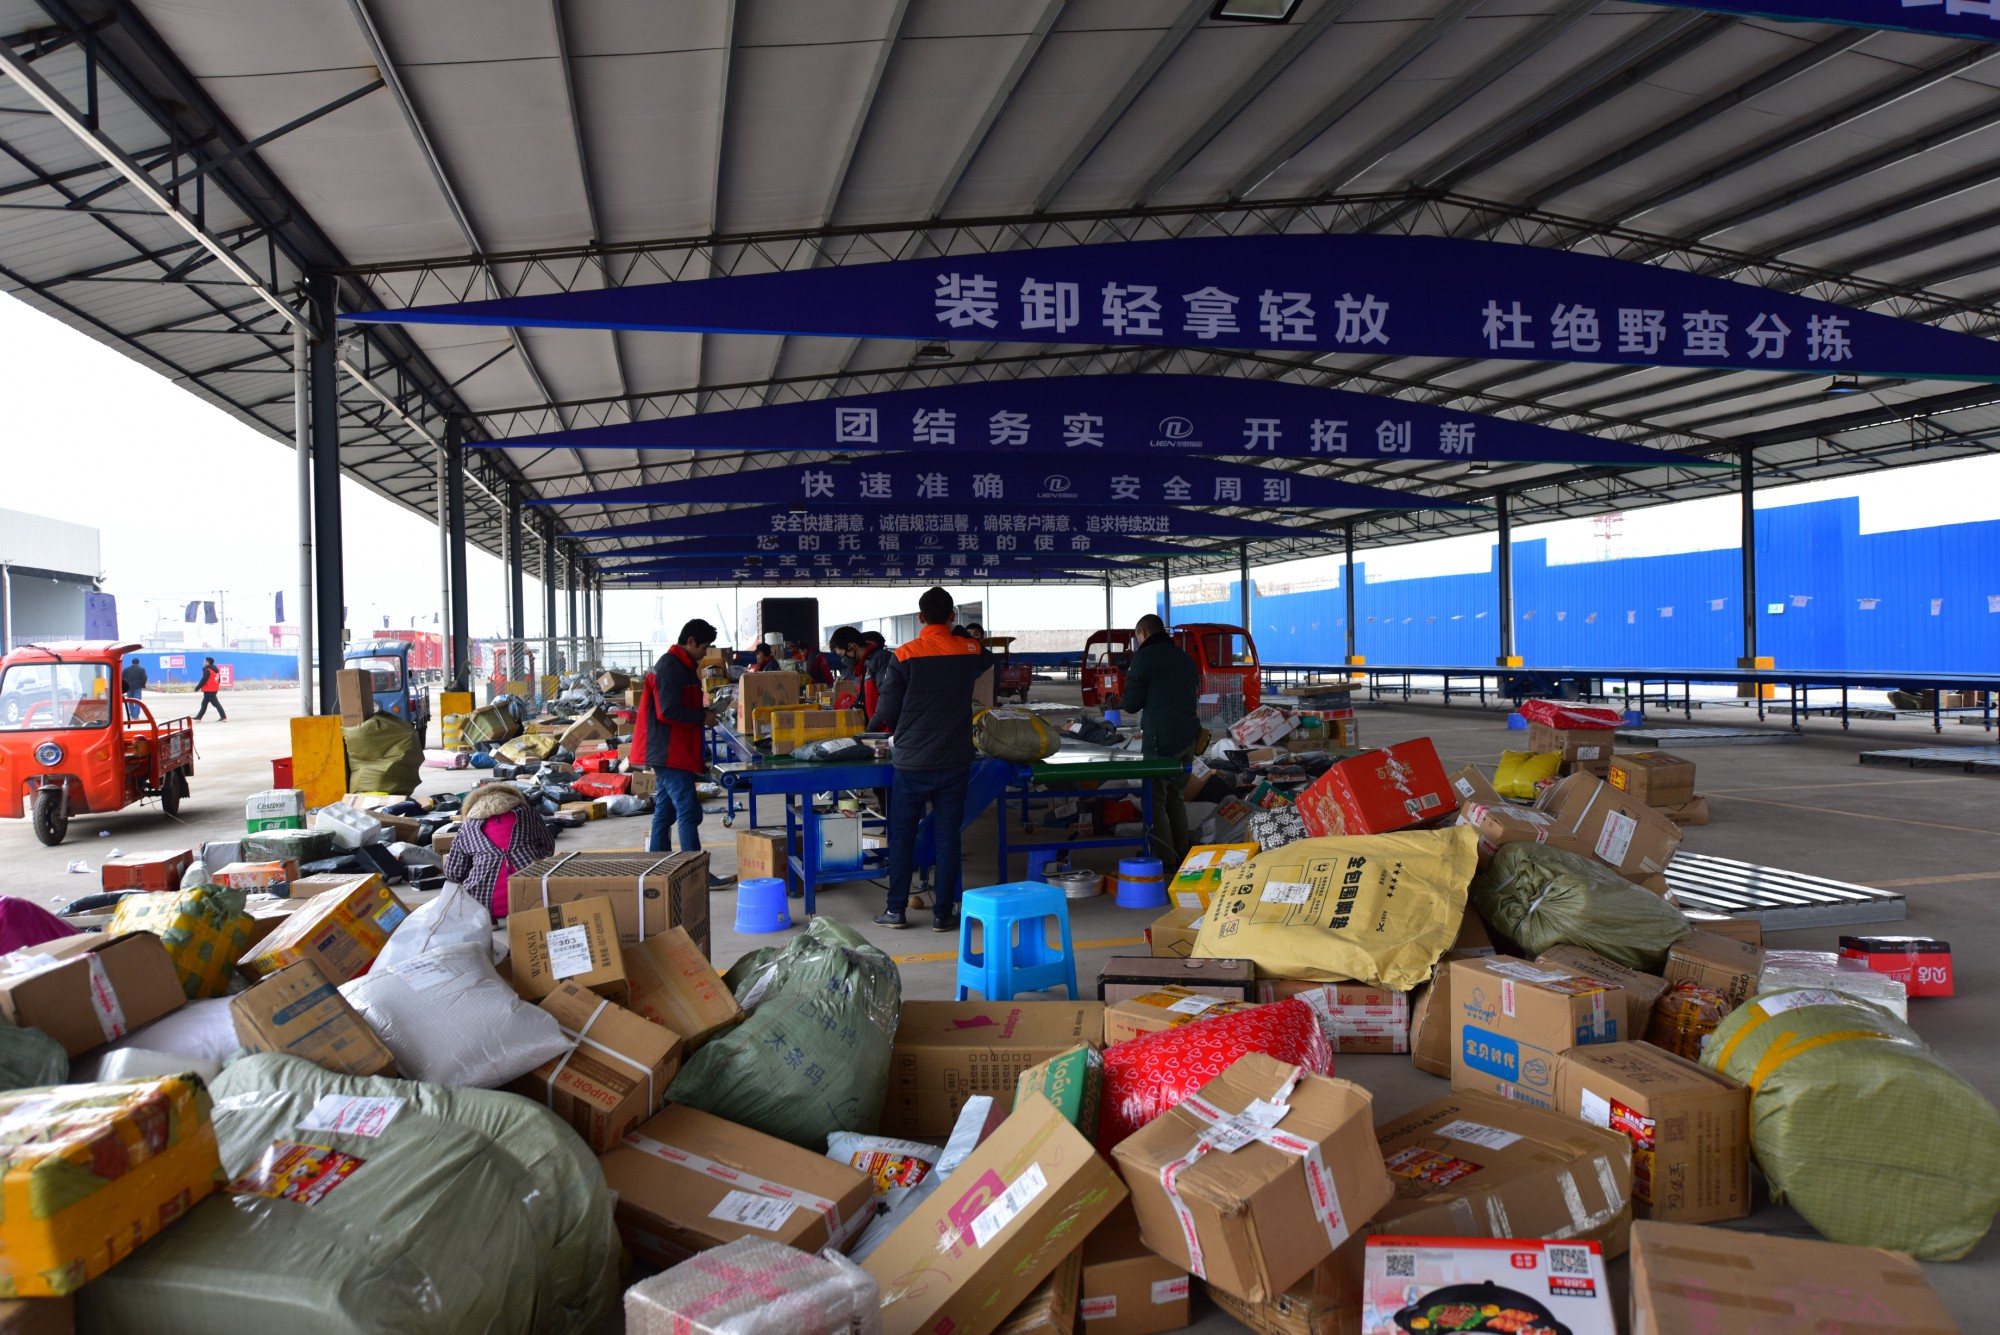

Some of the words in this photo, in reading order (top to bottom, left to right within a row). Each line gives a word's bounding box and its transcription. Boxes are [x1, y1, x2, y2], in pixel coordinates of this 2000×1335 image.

[934, 272, 1391, 345] 装卸轻拿轻放
[1482, 299, 1855, 362] 杜绝野蛮分拣
[834, 407, 1105, 447] 团结务实
[1242, 416, 1477, 456] 开拓创新
[800, 471, 1005, 500] 快速准确
[1110, 473, 1291, 502] 安全周到
